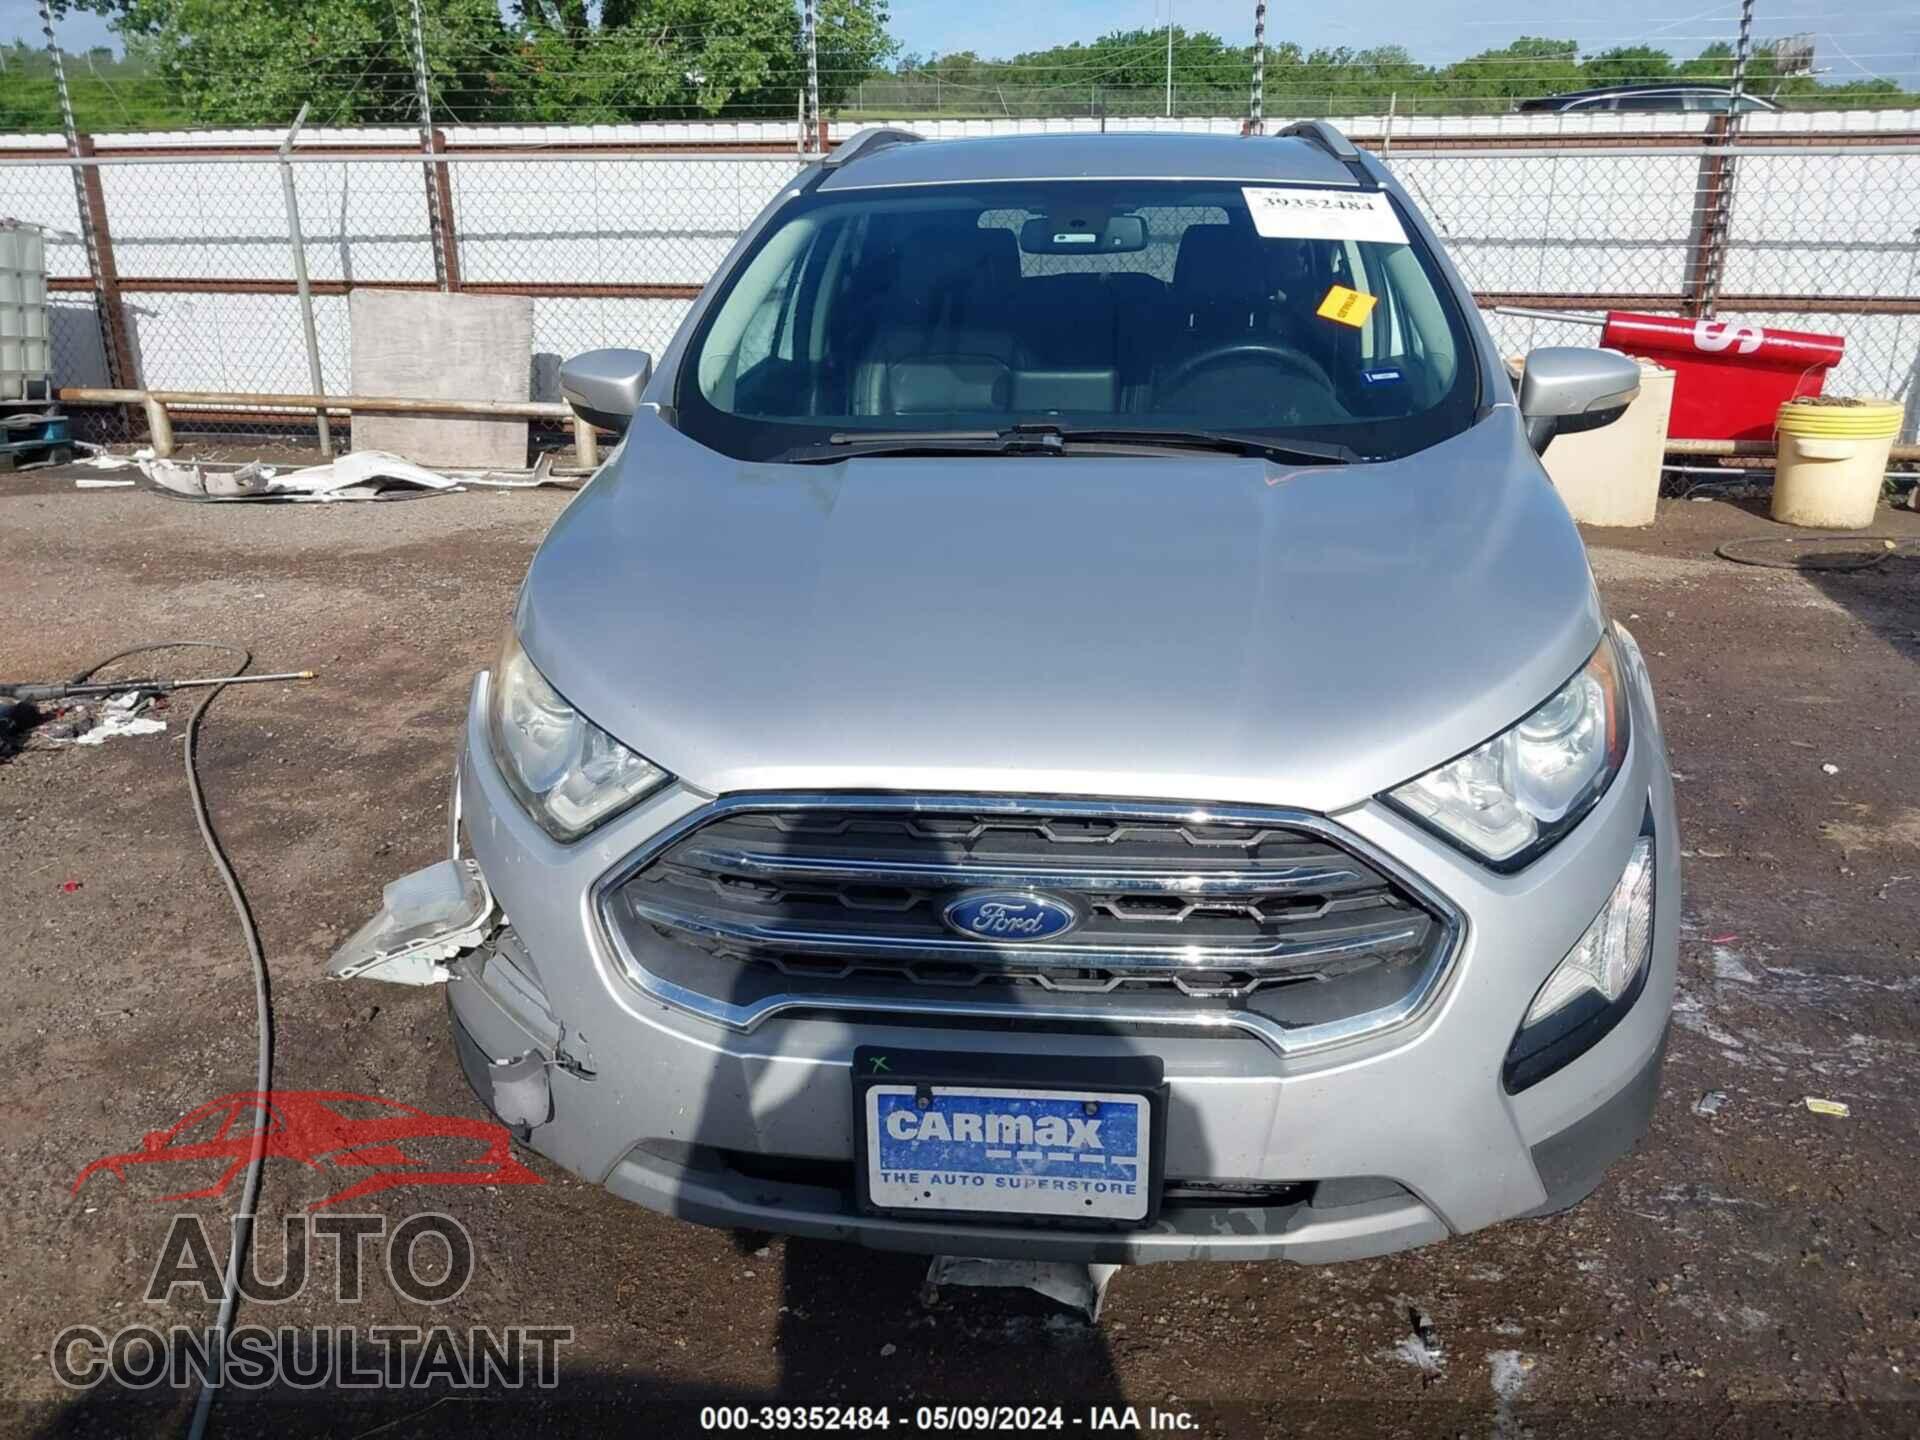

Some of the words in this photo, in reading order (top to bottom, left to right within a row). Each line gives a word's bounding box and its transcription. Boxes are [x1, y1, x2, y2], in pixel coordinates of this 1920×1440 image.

[1263, 196, 1375, 211] 39352484
[972, 902, 1045, 933] Ford
[881, 1172, 920, 1185] THE
[930, 1173, 986, 1187] AUTO
[995, 1177, 1137, 1195] SUPERSTORE
